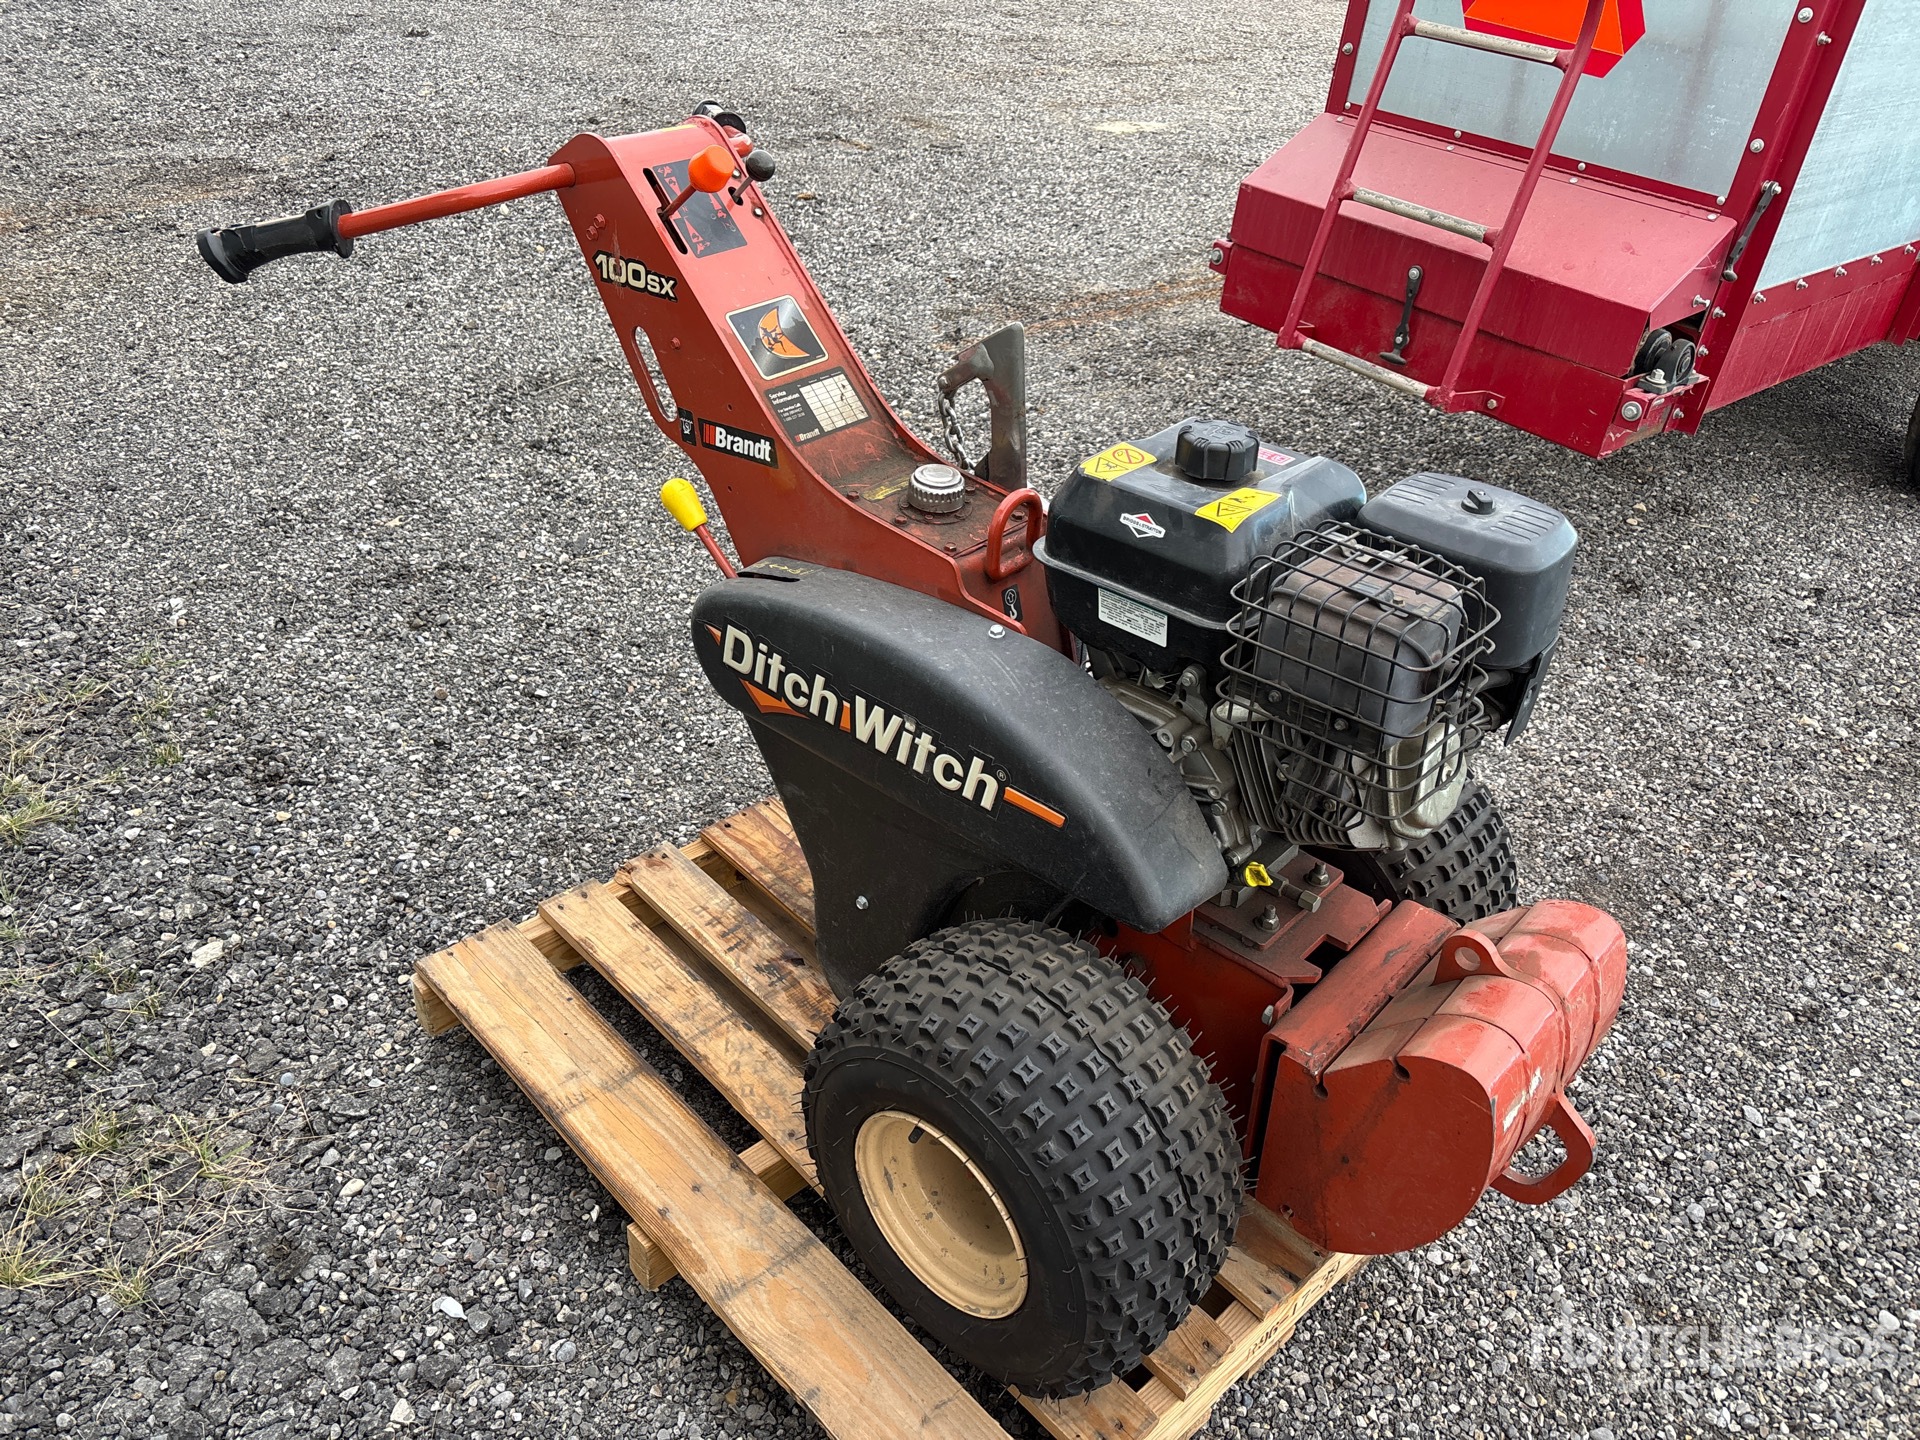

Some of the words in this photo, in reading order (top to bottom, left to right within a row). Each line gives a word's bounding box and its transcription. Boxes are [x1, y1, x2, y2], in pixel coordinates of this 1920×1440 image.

[715, 426, 772, 462] Brandt
[799, 428, 820, 442] Brandt
[722, 624, 839, 726] Ditch
[854, 695, 1000, 812] Witch
